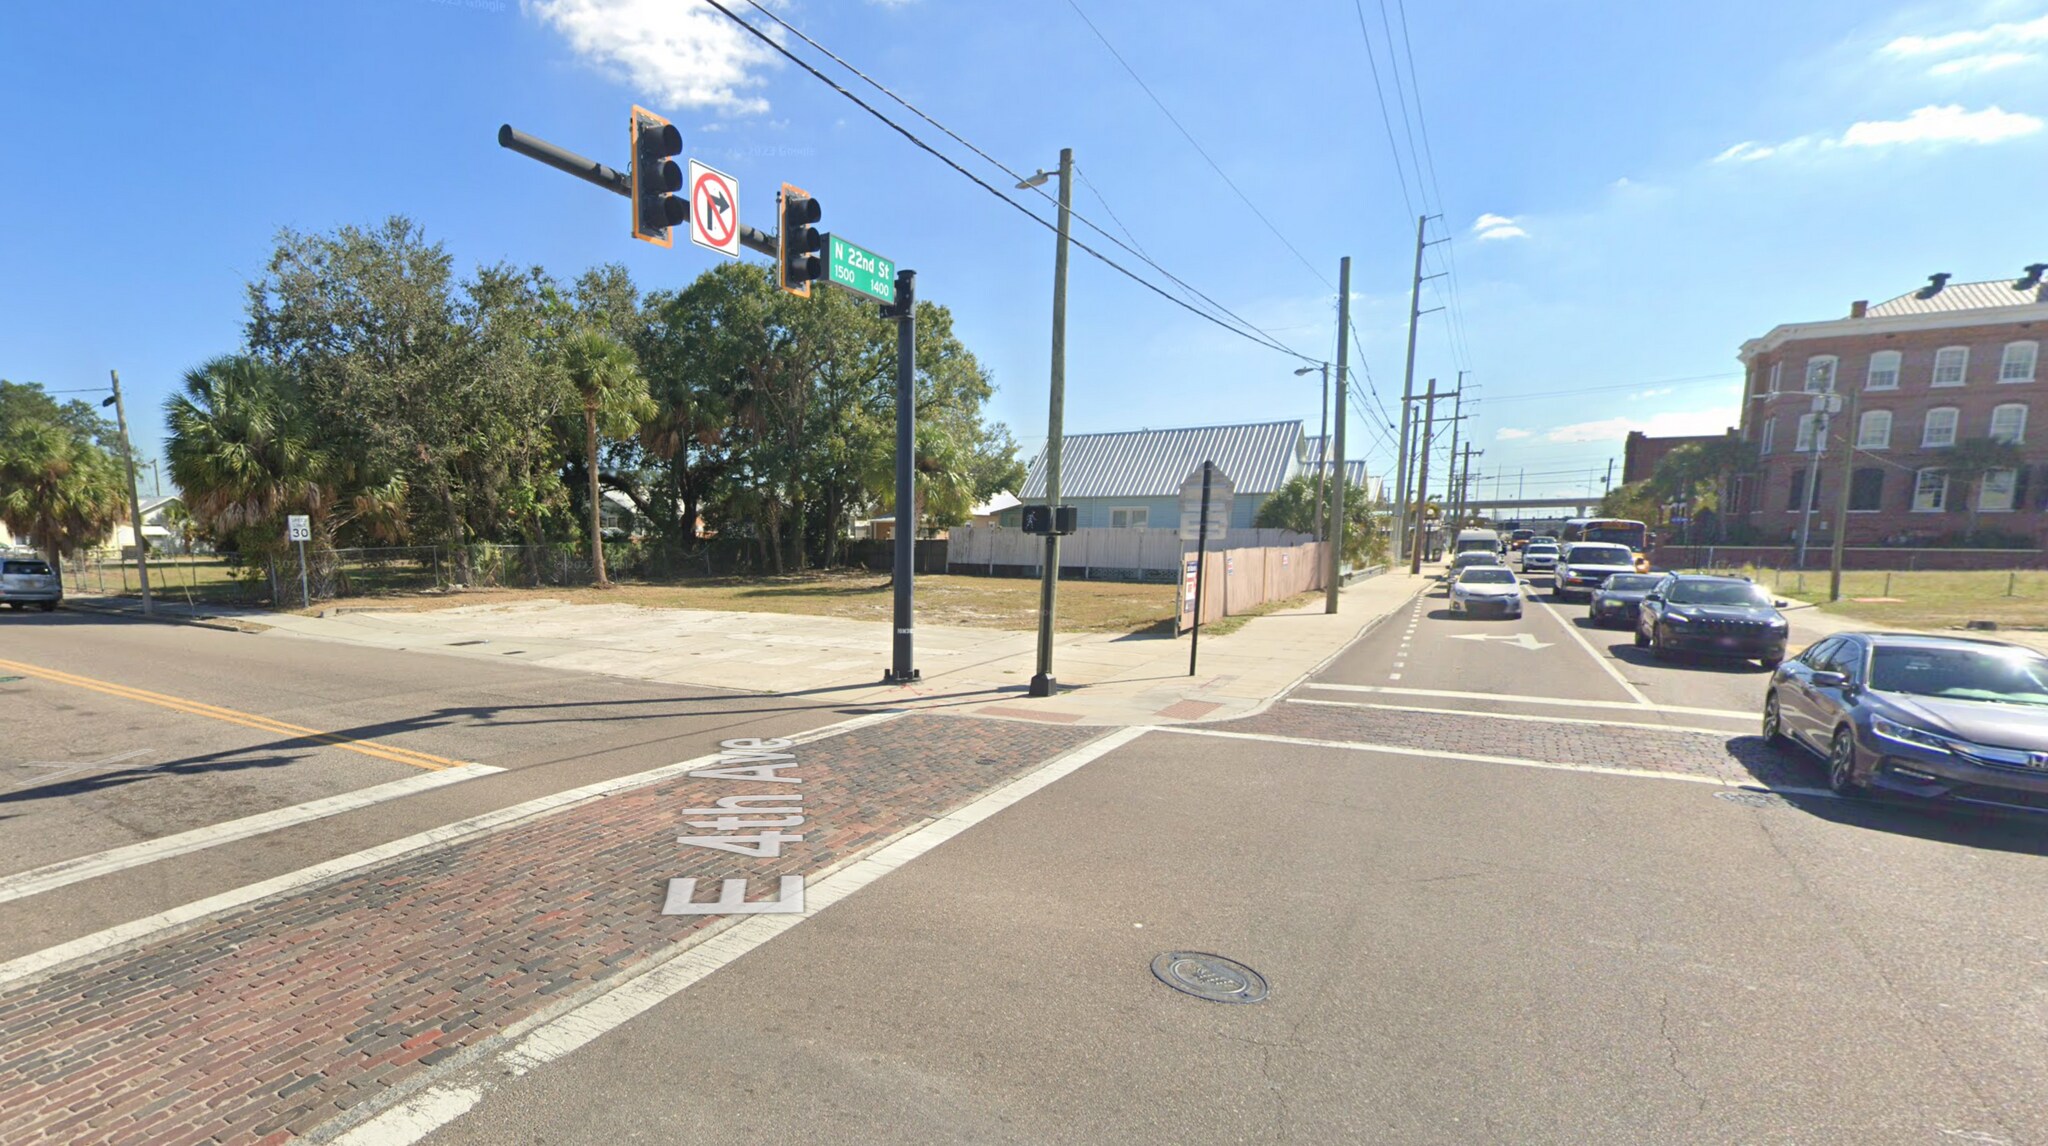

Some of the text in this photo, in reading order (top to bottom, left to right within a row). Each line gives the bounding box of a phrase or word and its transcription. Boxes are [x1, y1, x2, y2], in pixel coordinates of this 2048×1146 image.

[835, 241, 889, 280] N 22nd St
[834, 264, 889, 297] 1500 1400
[293, 528, 308, 538] 30
